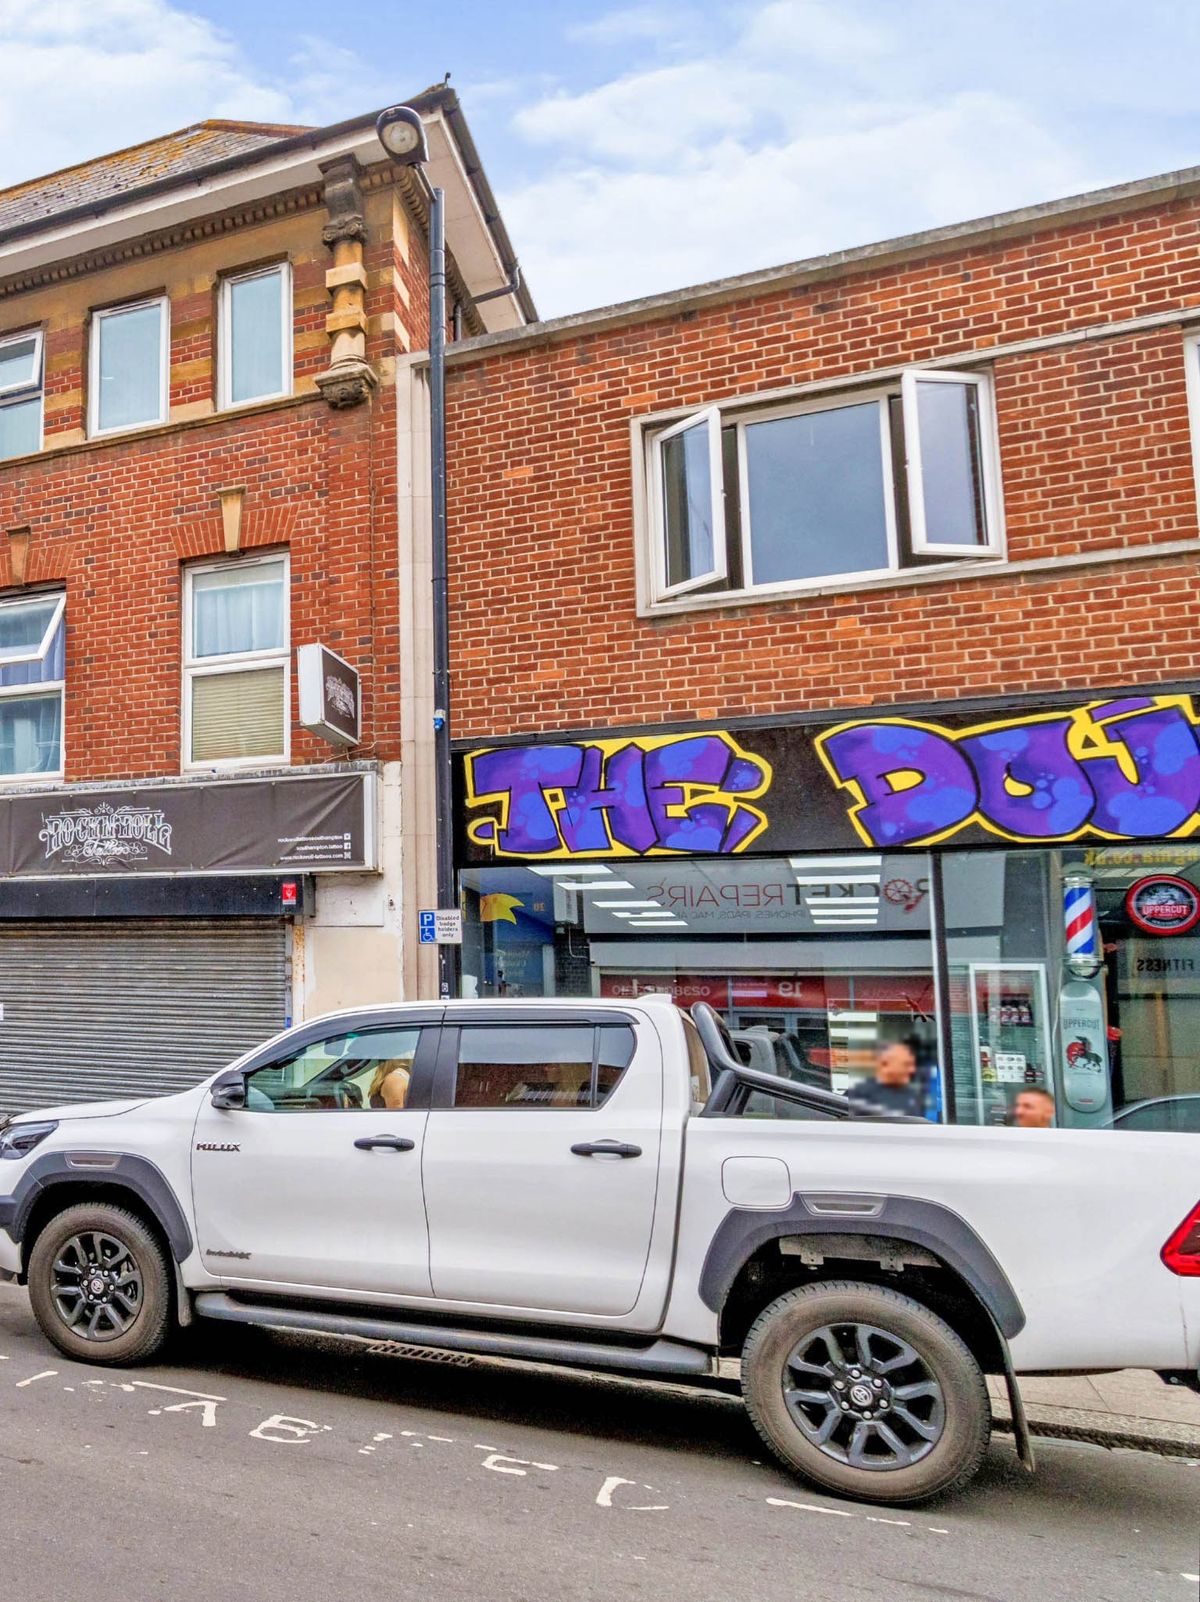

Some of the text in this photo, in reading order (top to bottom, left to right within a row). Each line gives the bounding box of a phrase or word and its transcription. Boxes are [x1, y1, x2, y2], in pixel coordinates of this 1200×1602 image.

[464, 735, 773, 859] THE
[1141, 905, 1188, 915] UPPERCUT
[423, 913, 433, 926] P
[196, 1143, 241, 1152] HILUX
